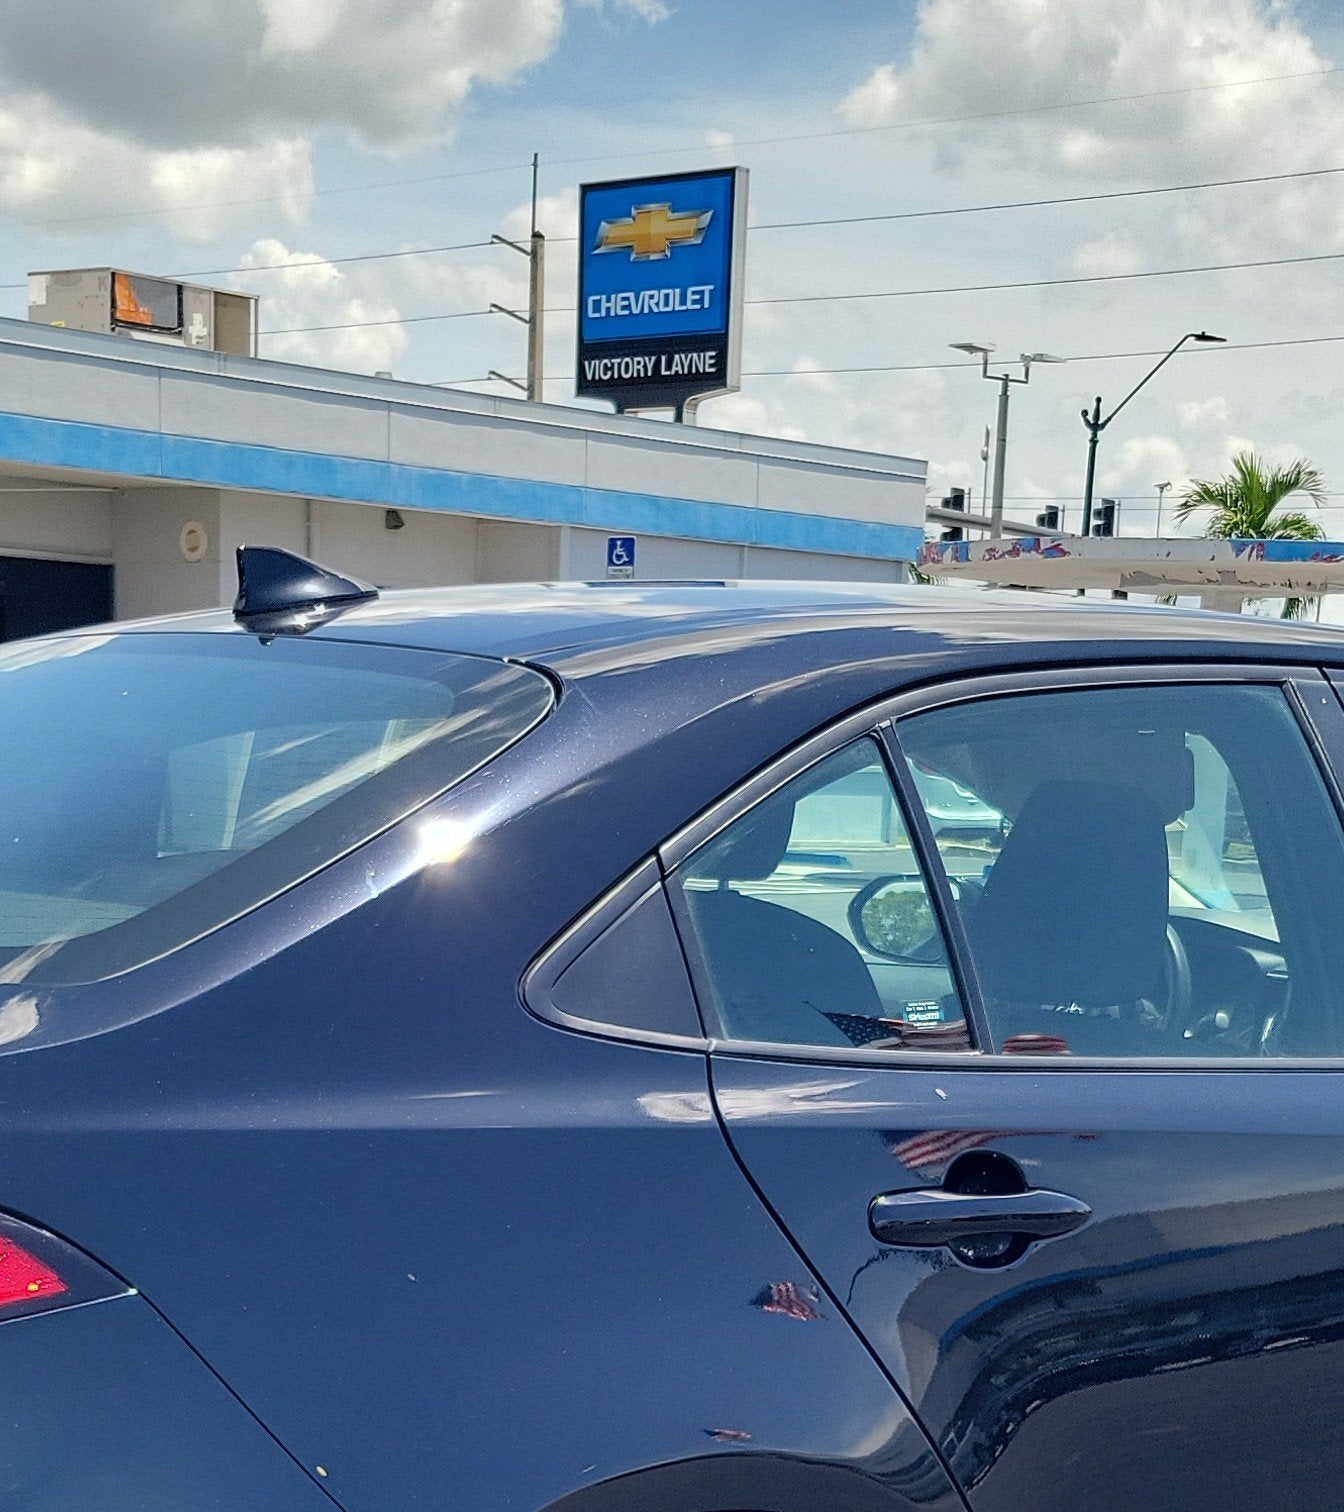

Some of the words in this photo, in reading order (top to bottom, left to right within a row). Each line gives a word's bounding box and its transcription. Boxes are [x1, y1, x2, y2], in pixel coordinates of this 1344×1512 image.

[587, 285, 715, 318] CHEVROLET
[584, 355, 656, 381] VICTORY
[660, 351, 718, 376] LAYNE
